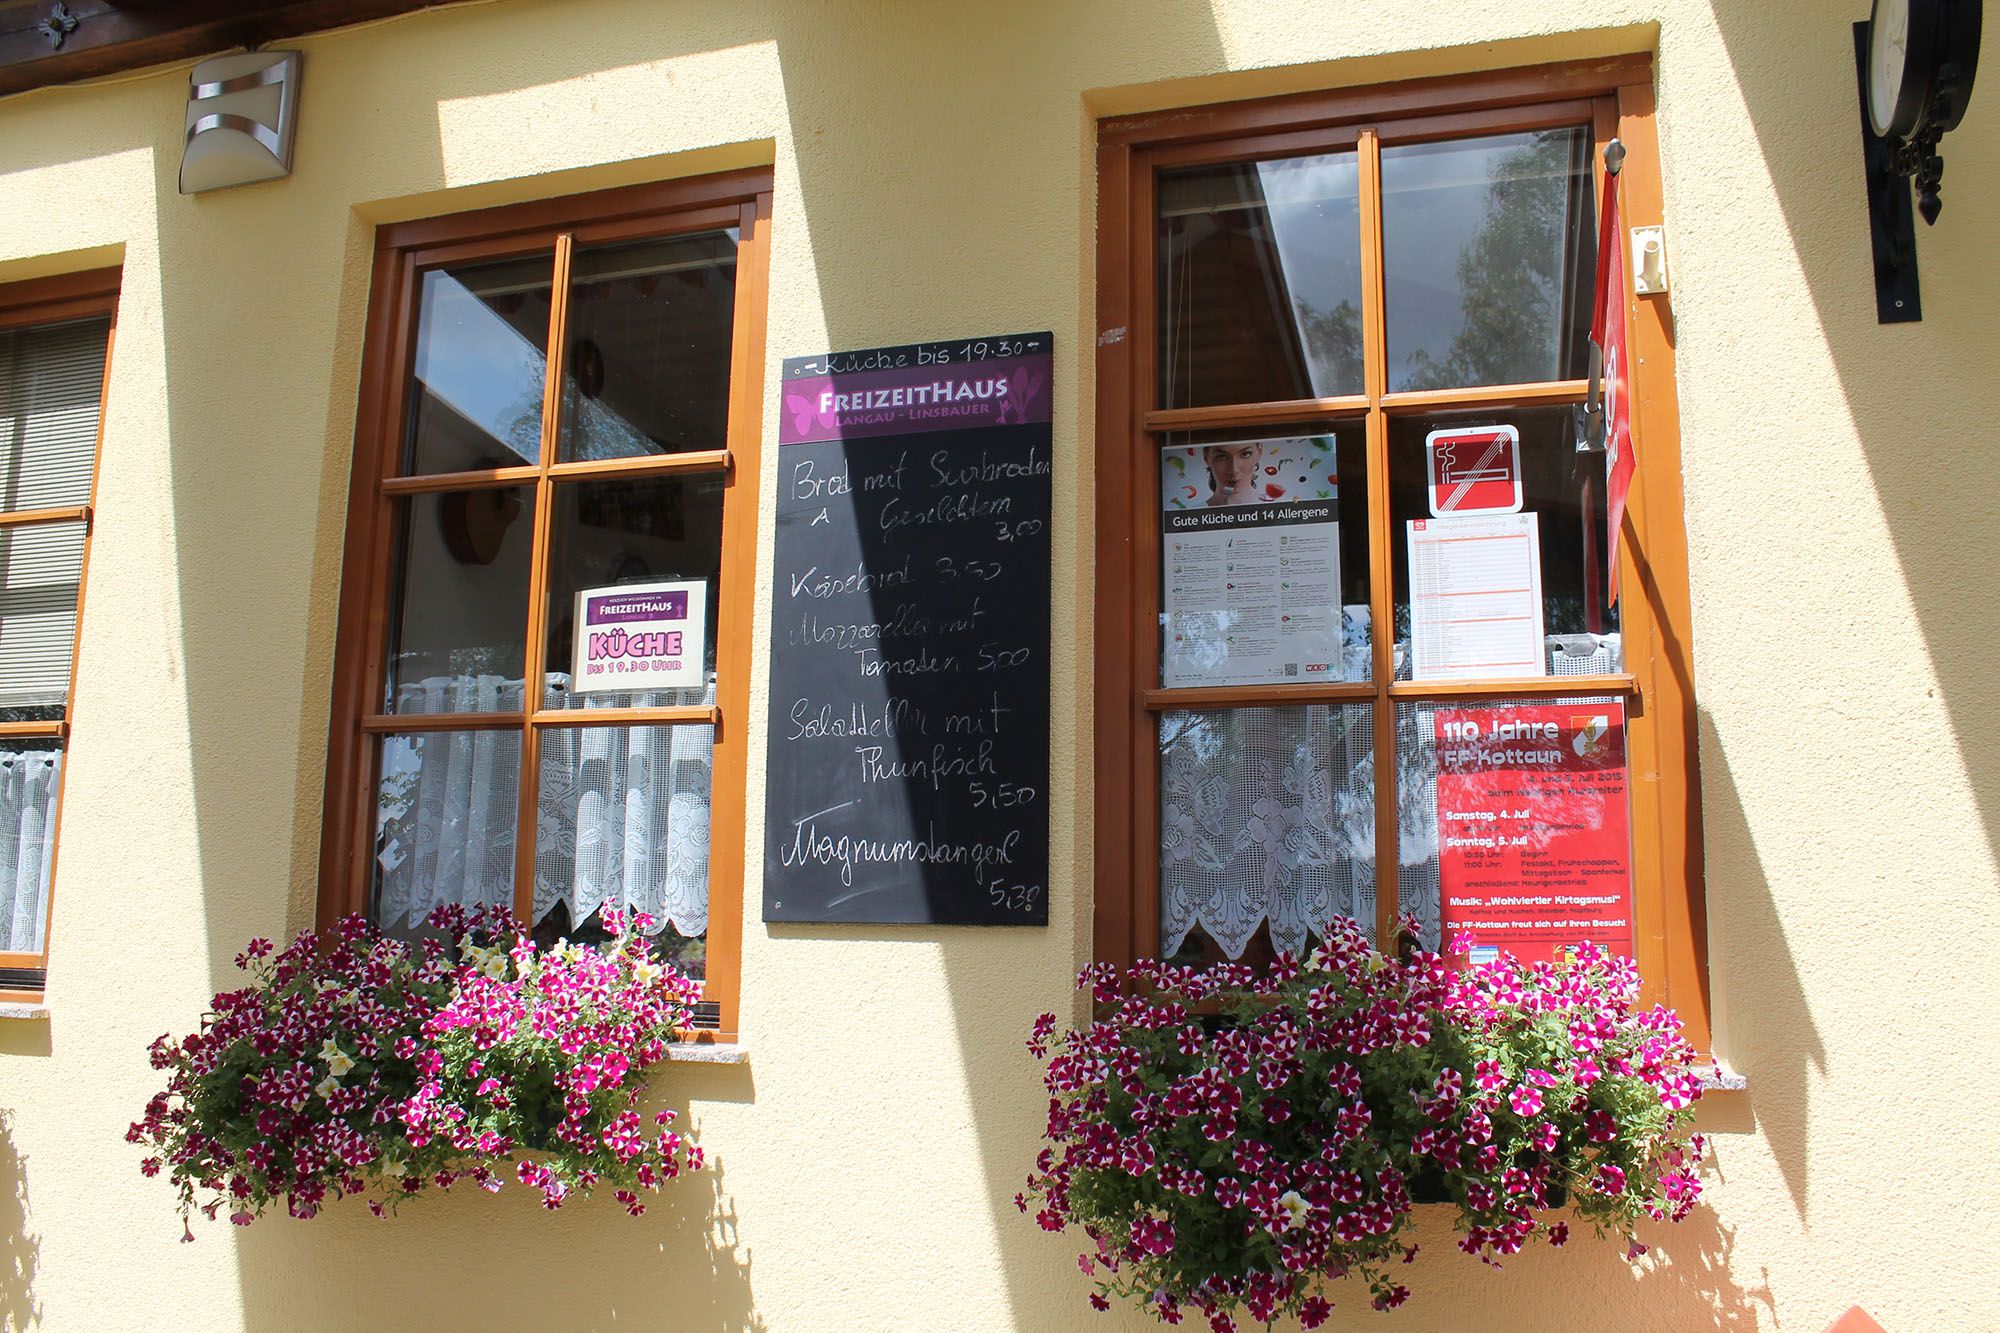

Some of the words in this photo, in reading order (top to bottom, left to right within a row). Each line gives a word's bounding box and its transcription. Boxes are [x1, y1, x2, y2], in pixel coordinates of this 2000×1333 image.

[917, 346, 951, 366] bis
[819, 377, 1009, 414] FREIZEITHAUS
[835, 411, 895, 427] LANGAU
[908, 403, 990, 420] LINSBAUER
[863, 450, 908, 492] mit
[1172, 515, 1198, 528] Gute
[1201, 512, 1235, 526] Küche
[1237, 510, 1258, 522] und
[1262, 510, 1275, 520] 14
[1277, 507, 1329, 520] Allergene
[599, 602, 672, 616] FREIZEITHAUS
[588, 627, 682, 661] KÜCHE
[608, 661, 649, 674] 19.30
[651, 660, 682, 672] UHR
[944, 690, 1012, 734] mit
[1443, 721, 1479, 743] 110
[1488, 719, 1560, 742] Jahre
[1443, 748, 1563, 767] FF-Kottaun
[1597, 772, 1623, 782] 2015
[1445, 810, 1497, 821] Samstag,
[1500, 809, 1511, 819] 4.
[1513, 809, 1530, 819] Juli
[1446, 837, 1496, 848] Sonntag,
[1498, 836, 1509, 846] 5.
[1511, 835, 1528, 846] Juli
[1449, 897, 1483, 906] Musik:
[1447, 921, 1460, 929] Die
[1462, 921, 1510, 929] FF-Kottaun
[1511, 920, 1533, 928] freut
[1535, 920, 1551, 928] sich
[1553, 919, 1568, 928] auf
[1569, 919, 1591, 928] Ihren
[1592, 919, 1626, 927] Besuch!
